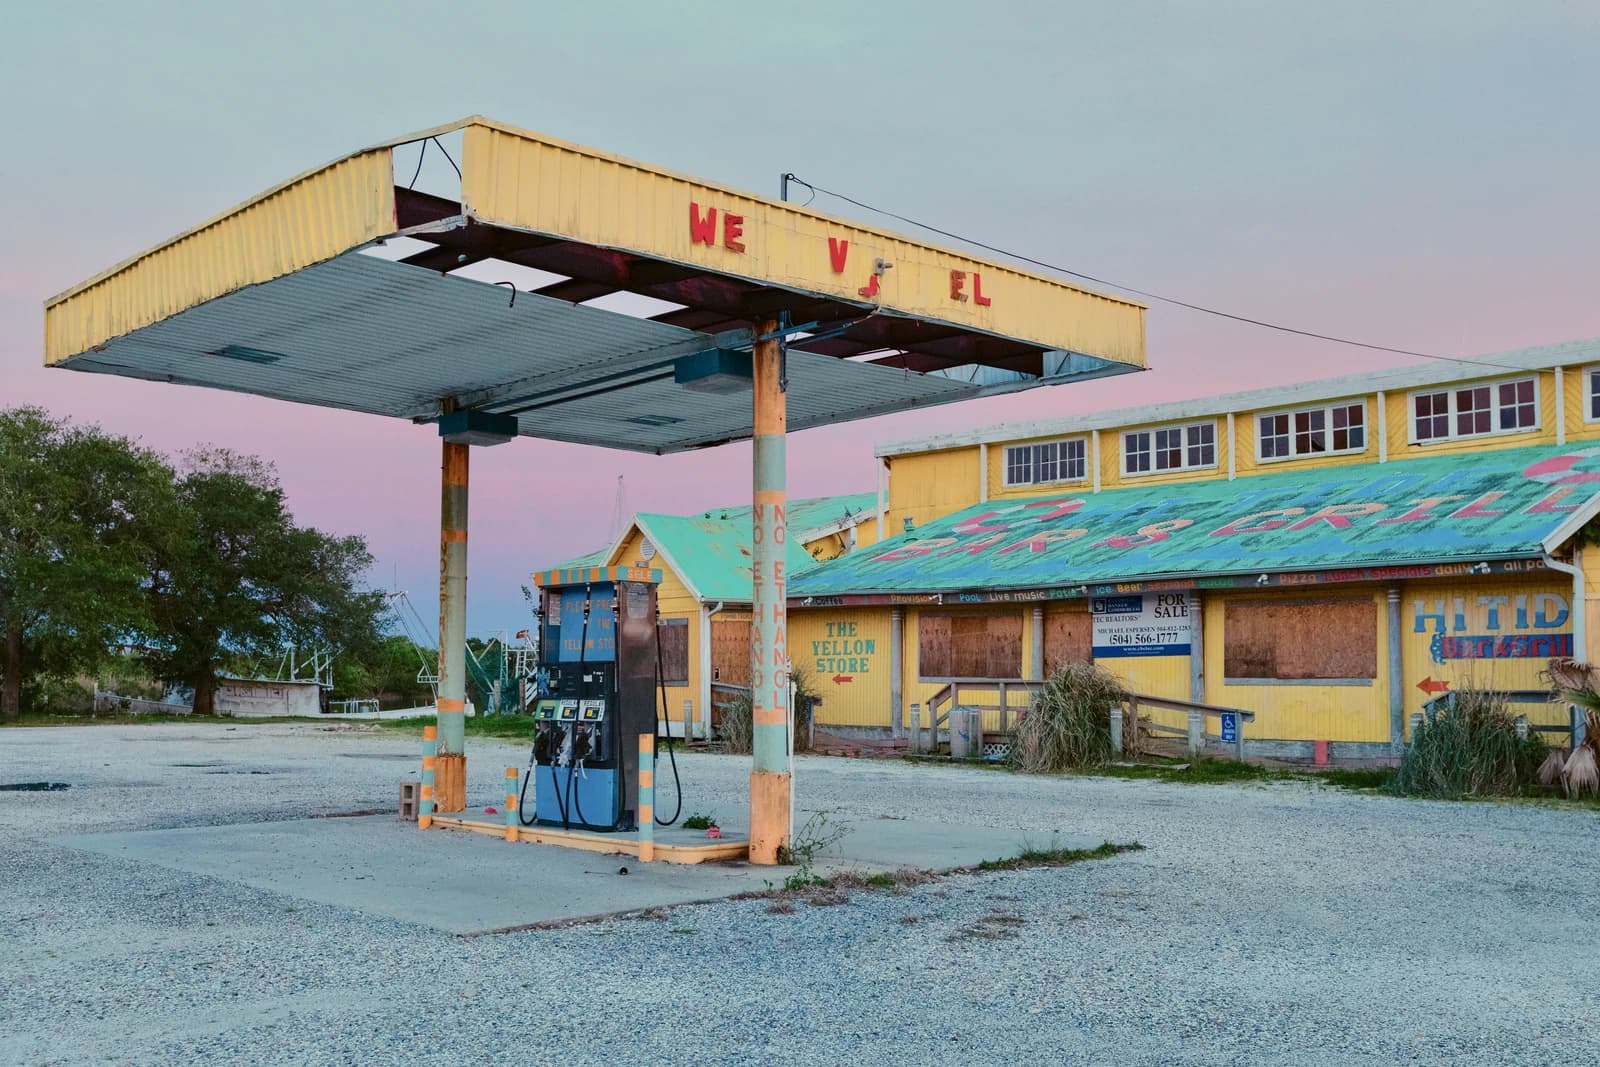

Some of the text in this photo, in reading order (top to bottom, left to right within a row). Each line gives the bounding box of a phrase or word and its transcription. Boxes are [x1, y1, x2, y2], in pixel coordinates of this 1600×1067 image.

[690, 202, 746, 253] WE
[828, 237, 848, 273] V
[951, 269, 992, 307] EL
[869, 530, 1088, 562] BAR
[1208, 487, 1580, 538] GRILL
[627, 568, 652, 579] SELF
[1014, 590, 1045, 601] music
[1158, 594, 1184, 606] FOR
[774, 505, 785, 709] NO ETHANOL
[1154, 606, 1189, 619] SALE
[826, 622, 856, 637] THE
[1109, 632, 1178, 645] (504) 566-1777
[812, 639, 876, 656] YELLOW
[816, 657, 870, 674] STORE
